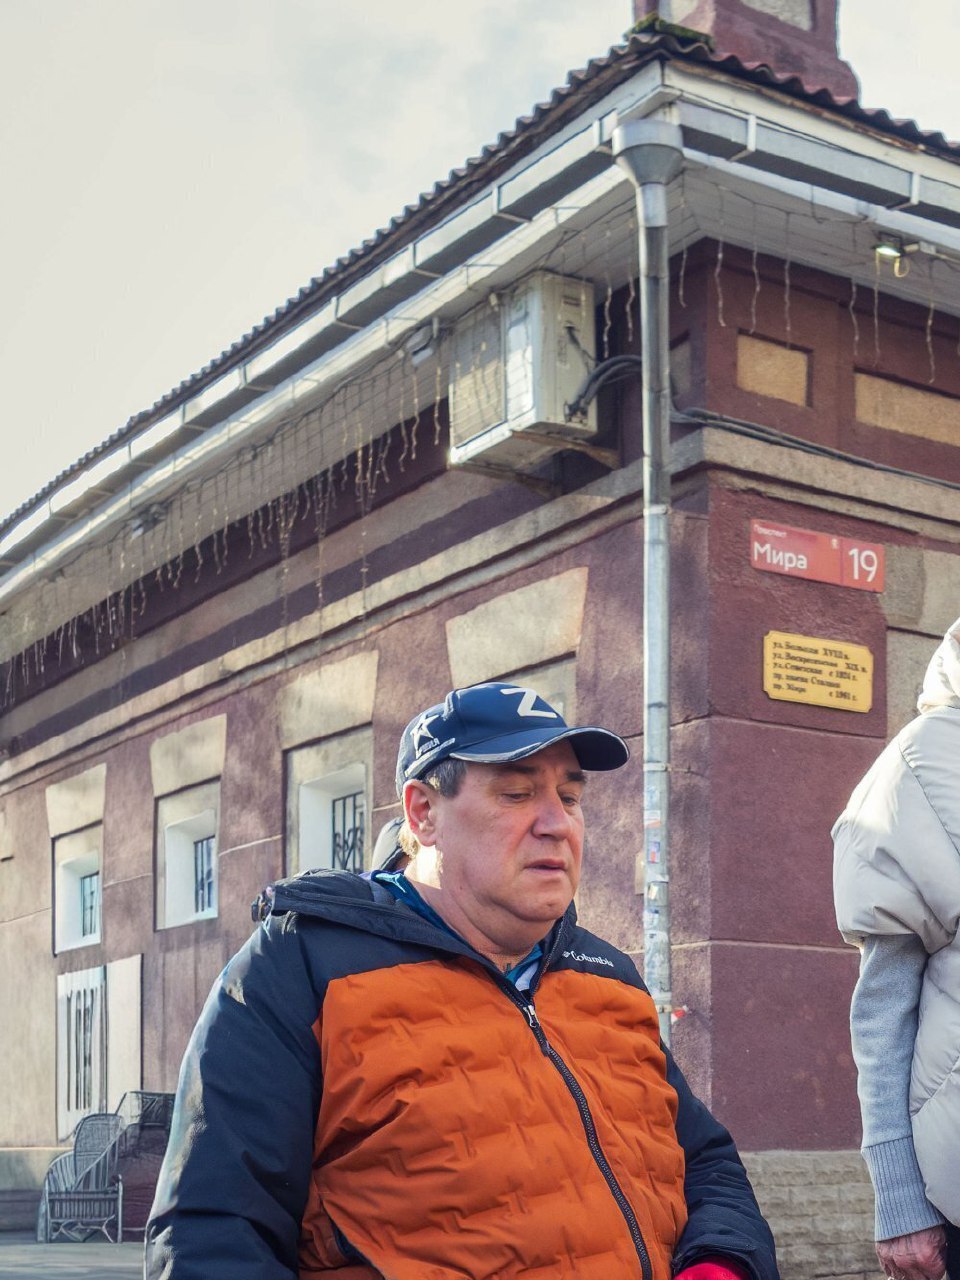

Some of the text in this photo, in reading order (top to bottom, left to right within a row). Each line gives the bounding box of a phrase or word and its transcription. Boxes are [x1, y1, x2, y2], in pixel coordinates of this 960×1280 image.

[753, 541, 808, 571] Мира
[848, 547, 878, 582] 19
[500, 687, 558, 719] Z
[570, 950, 614, 968] Columbia
